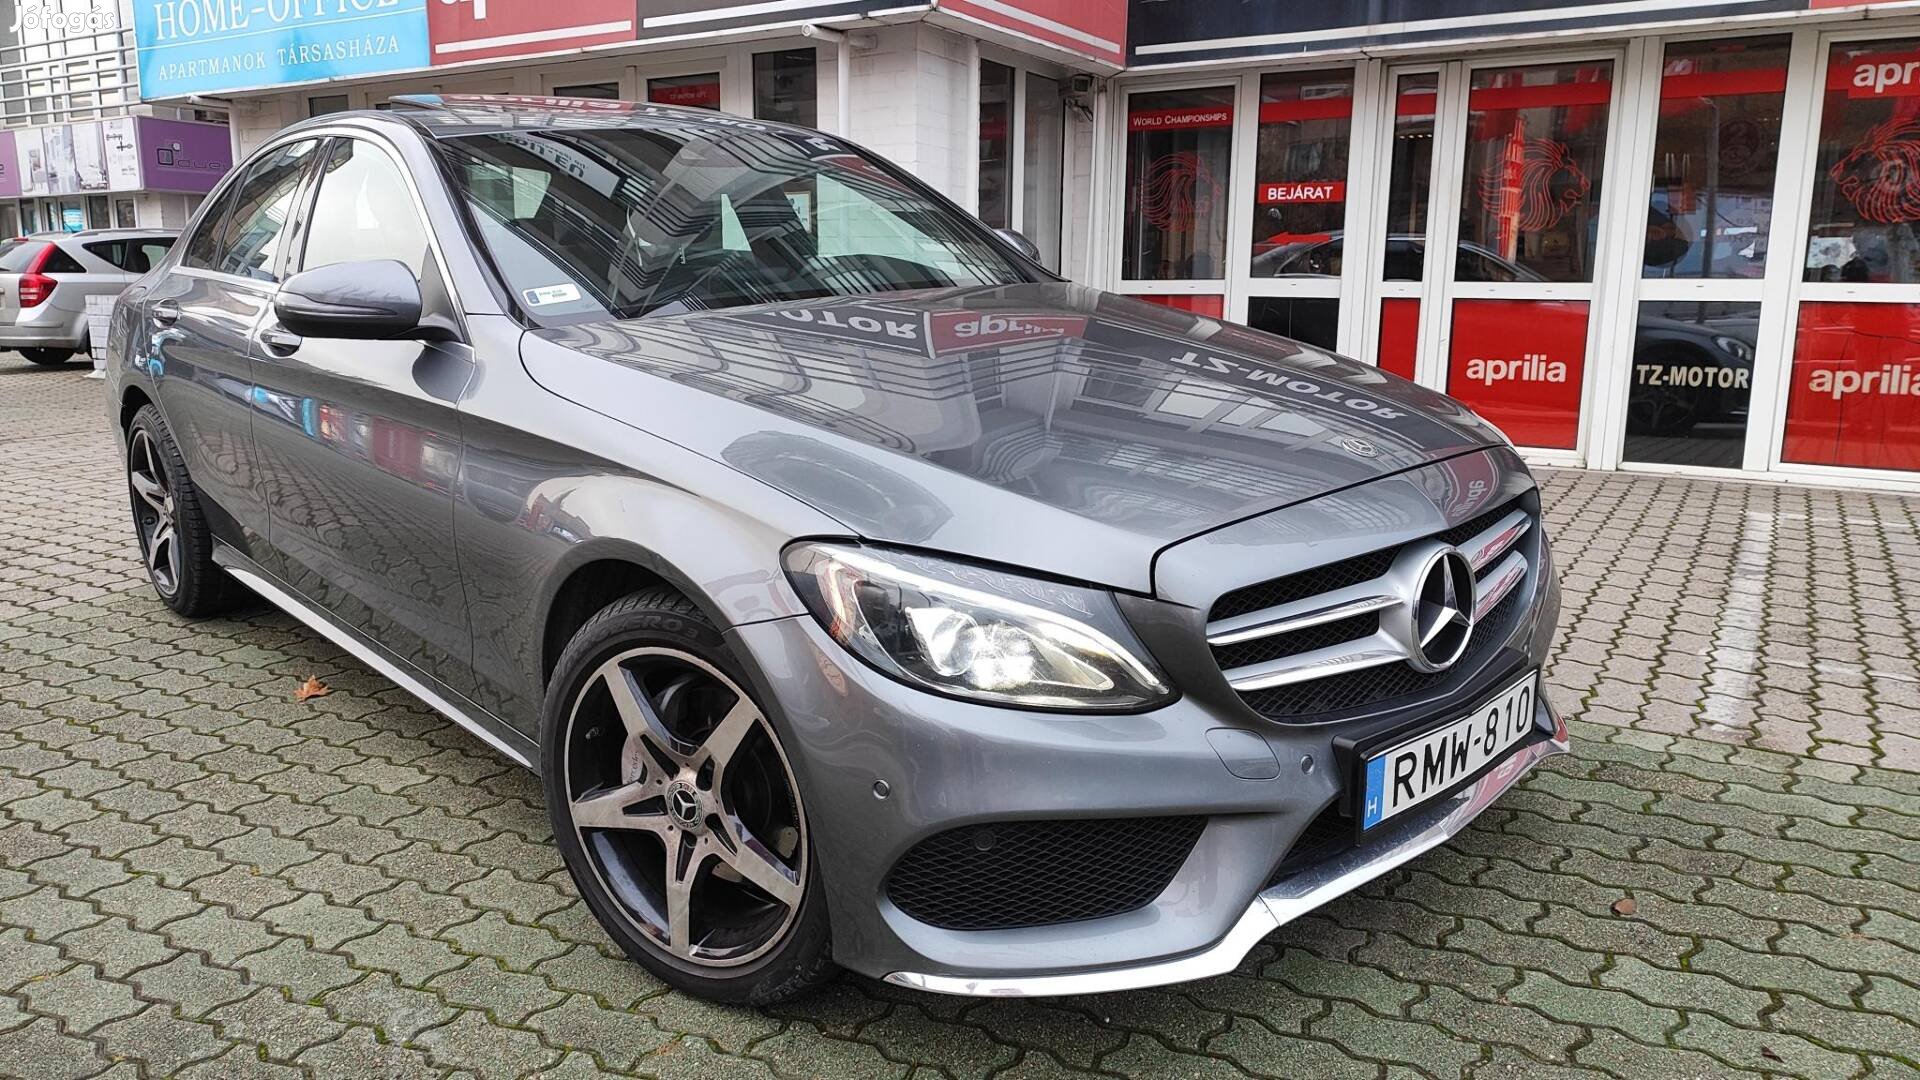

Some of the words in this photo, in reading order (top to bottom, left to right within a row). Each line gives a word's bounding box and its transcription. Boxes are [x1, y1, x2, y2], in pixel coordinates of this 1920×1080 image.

[154, 0, 399, 40] HOME-OFF
[159, 52, 266, 81] APARTMANOK
[277, 34, 399, 66] TÁRSASHÁZA
[1267, 184, 1333, 200] BEJÁRAT
[1466, 354, 1567, 386] aprilia
[1636, 364, 1750, 389] TZ-MOTOR
[1392, 686, 1530, 808] RMW-810
[1367, 796, 1378, 818] H
